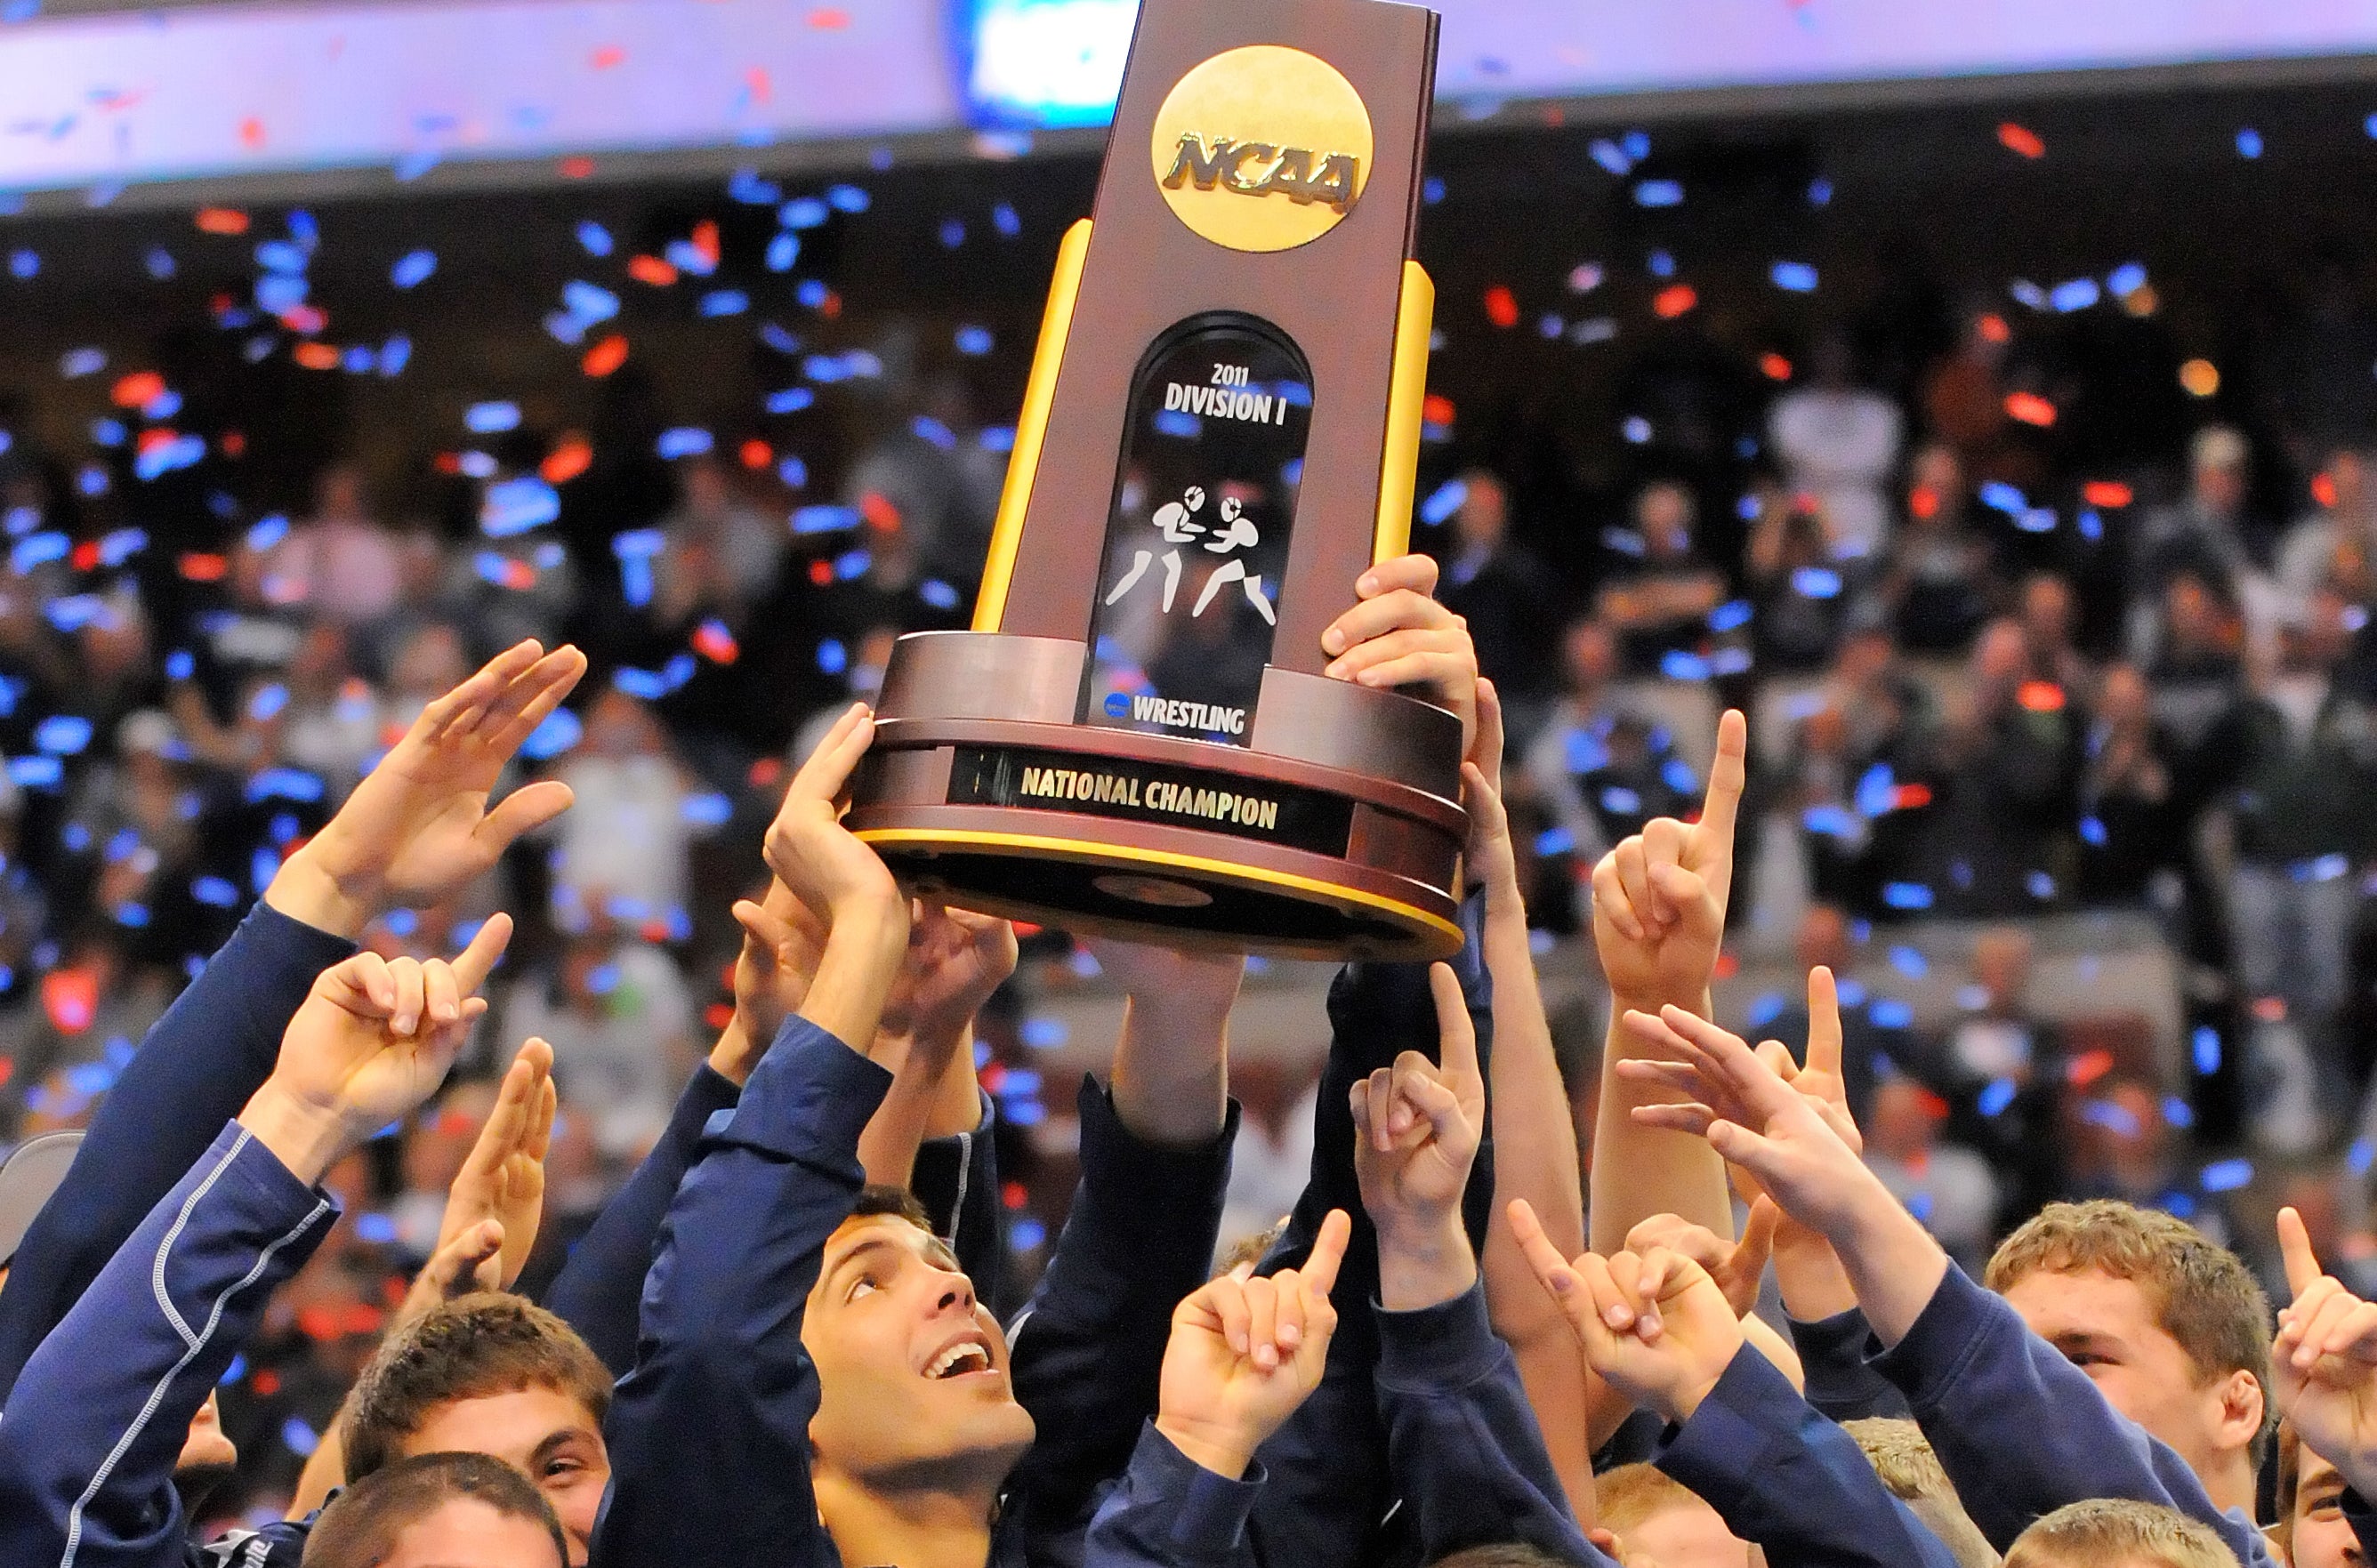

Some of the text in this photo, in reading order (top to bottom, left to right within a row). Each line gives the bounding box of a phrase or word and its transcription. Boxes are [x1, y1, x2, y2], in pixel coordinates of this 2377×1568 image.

[1162, 131, 1359, 214] NCAA
[1211, 363, 1249, 387] 2011
[1164, 382, 1287, 426] DIVISION I
[1133, 696, 1245, 735] WRESTLING
[1020, 768, 1278, 830] NATIONAL CHAMPION
